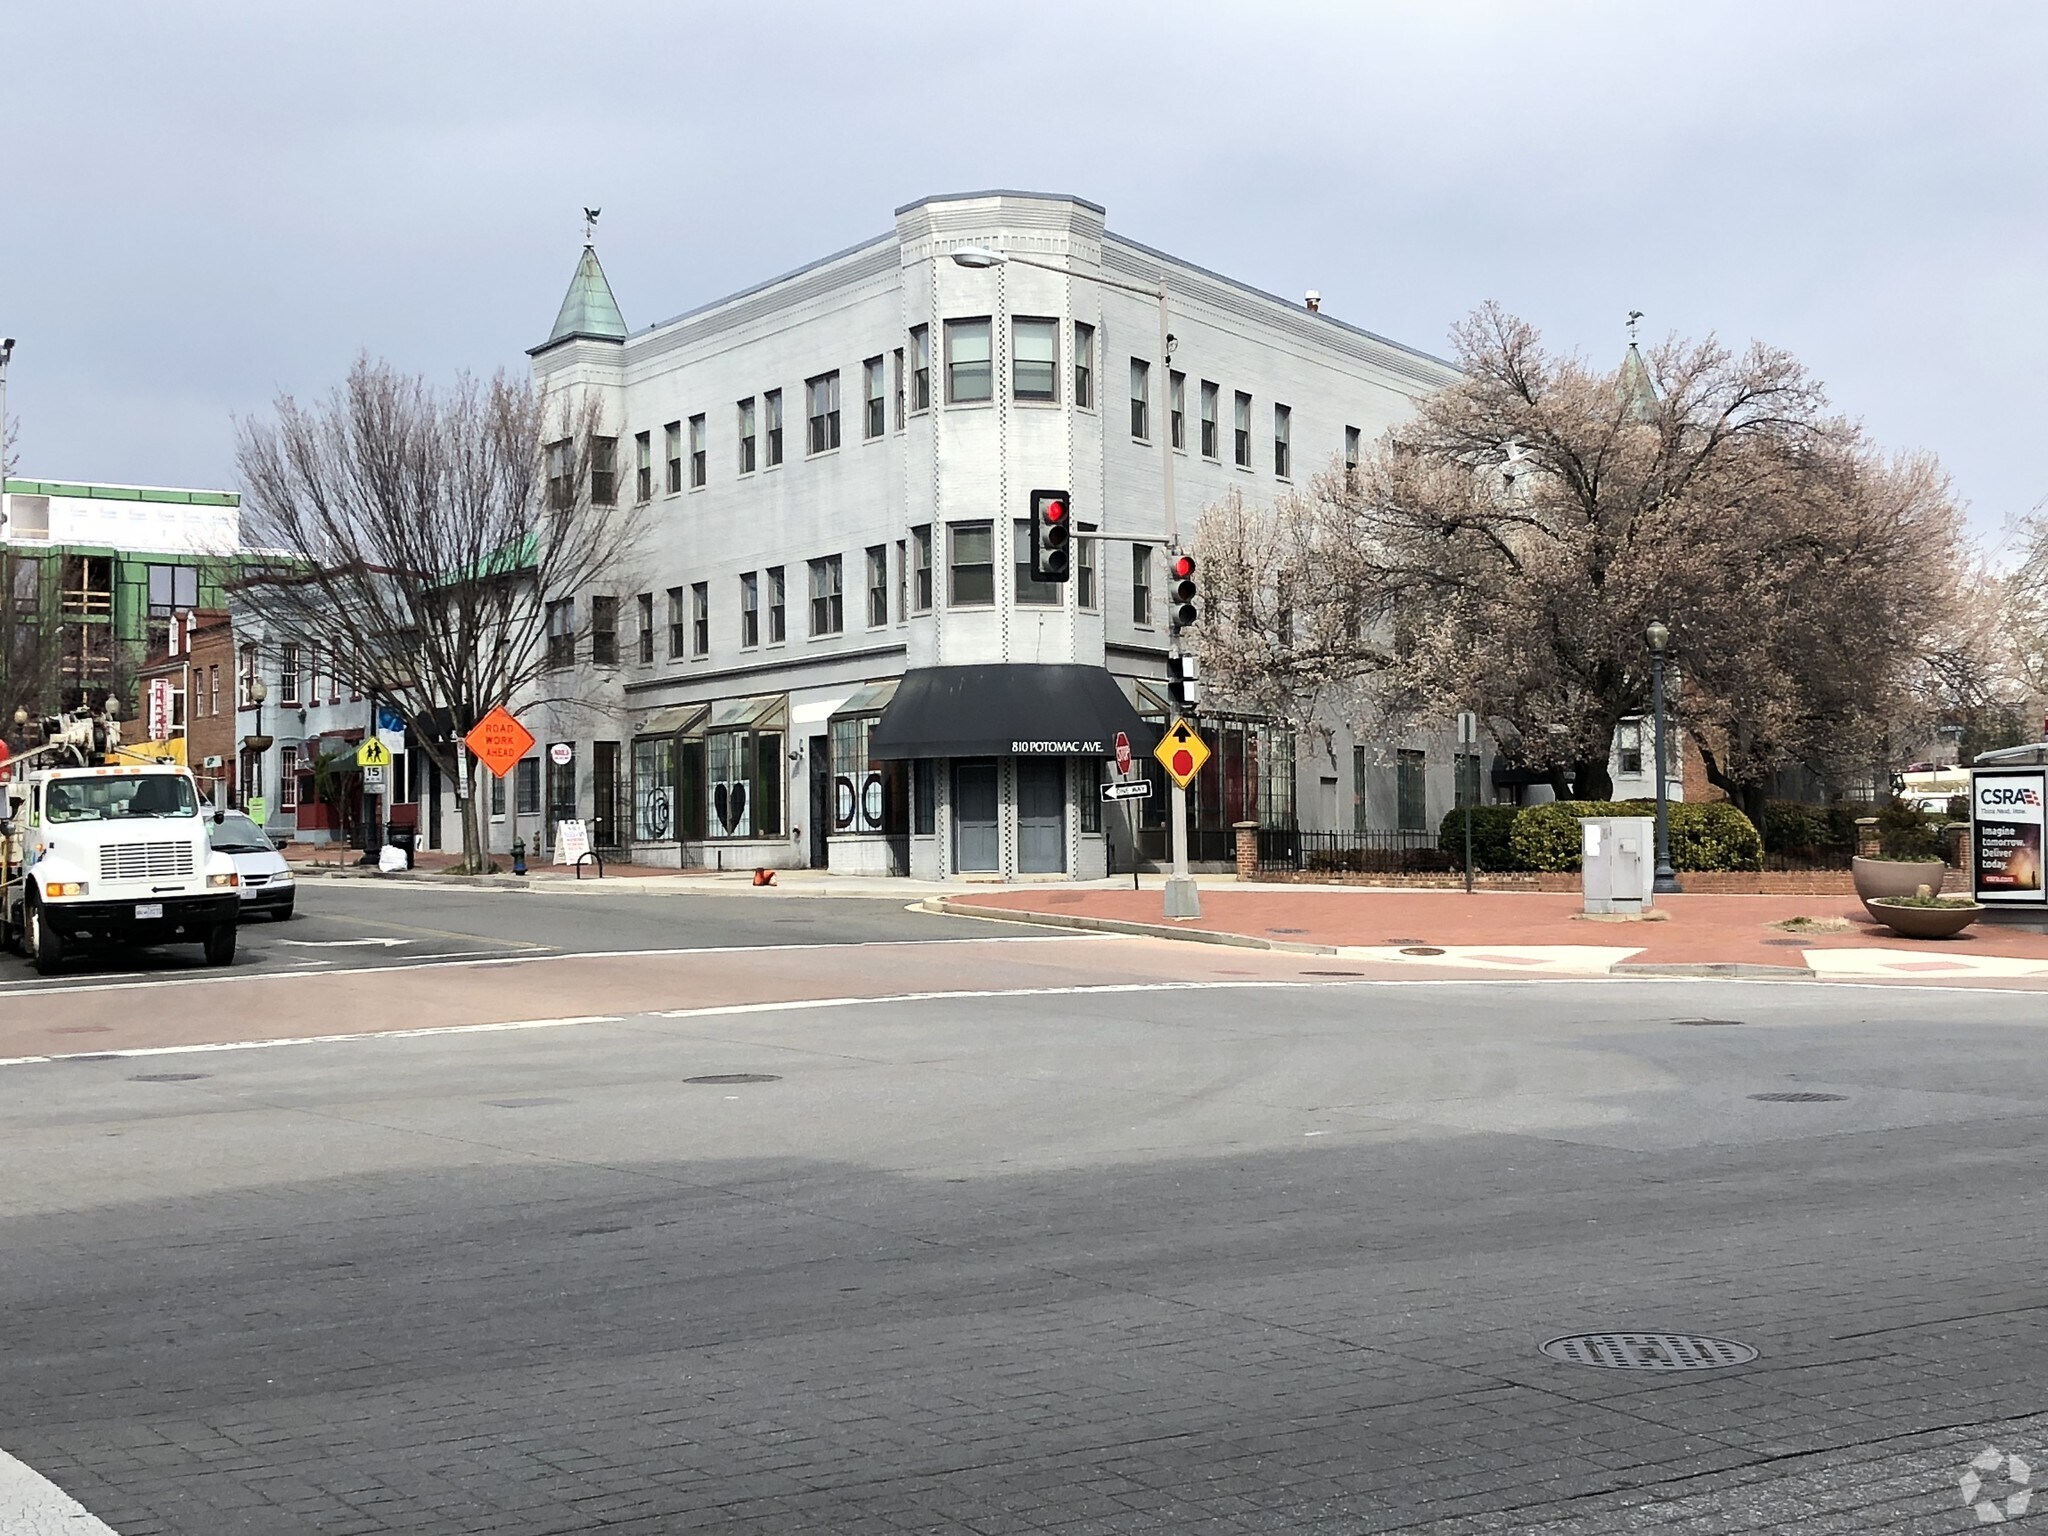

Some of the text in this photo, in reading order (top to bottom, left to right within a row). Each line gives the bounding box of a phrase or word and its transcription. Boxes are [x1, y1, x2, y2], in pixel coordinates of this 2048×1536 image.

[486, 724, 514, 733] ROAD
[486, 736, 514, 745] WORK
[1011, 741, 1104, 752] 810 POTOMAC AVE.
[486, 748, 515, 757] AHEAD
[367, 767, 380, 776] 15
[1116, 786, 1130, 795] ONE
[1981, 788, 2026, 805] CSRA
[1982, 826, 2015, 837] Imagine
[1982, 837, 2026, 847] tomorrow.
[1982, 848, 2013, 858] Deliver
[1982, 859, 2008, 870] today.
